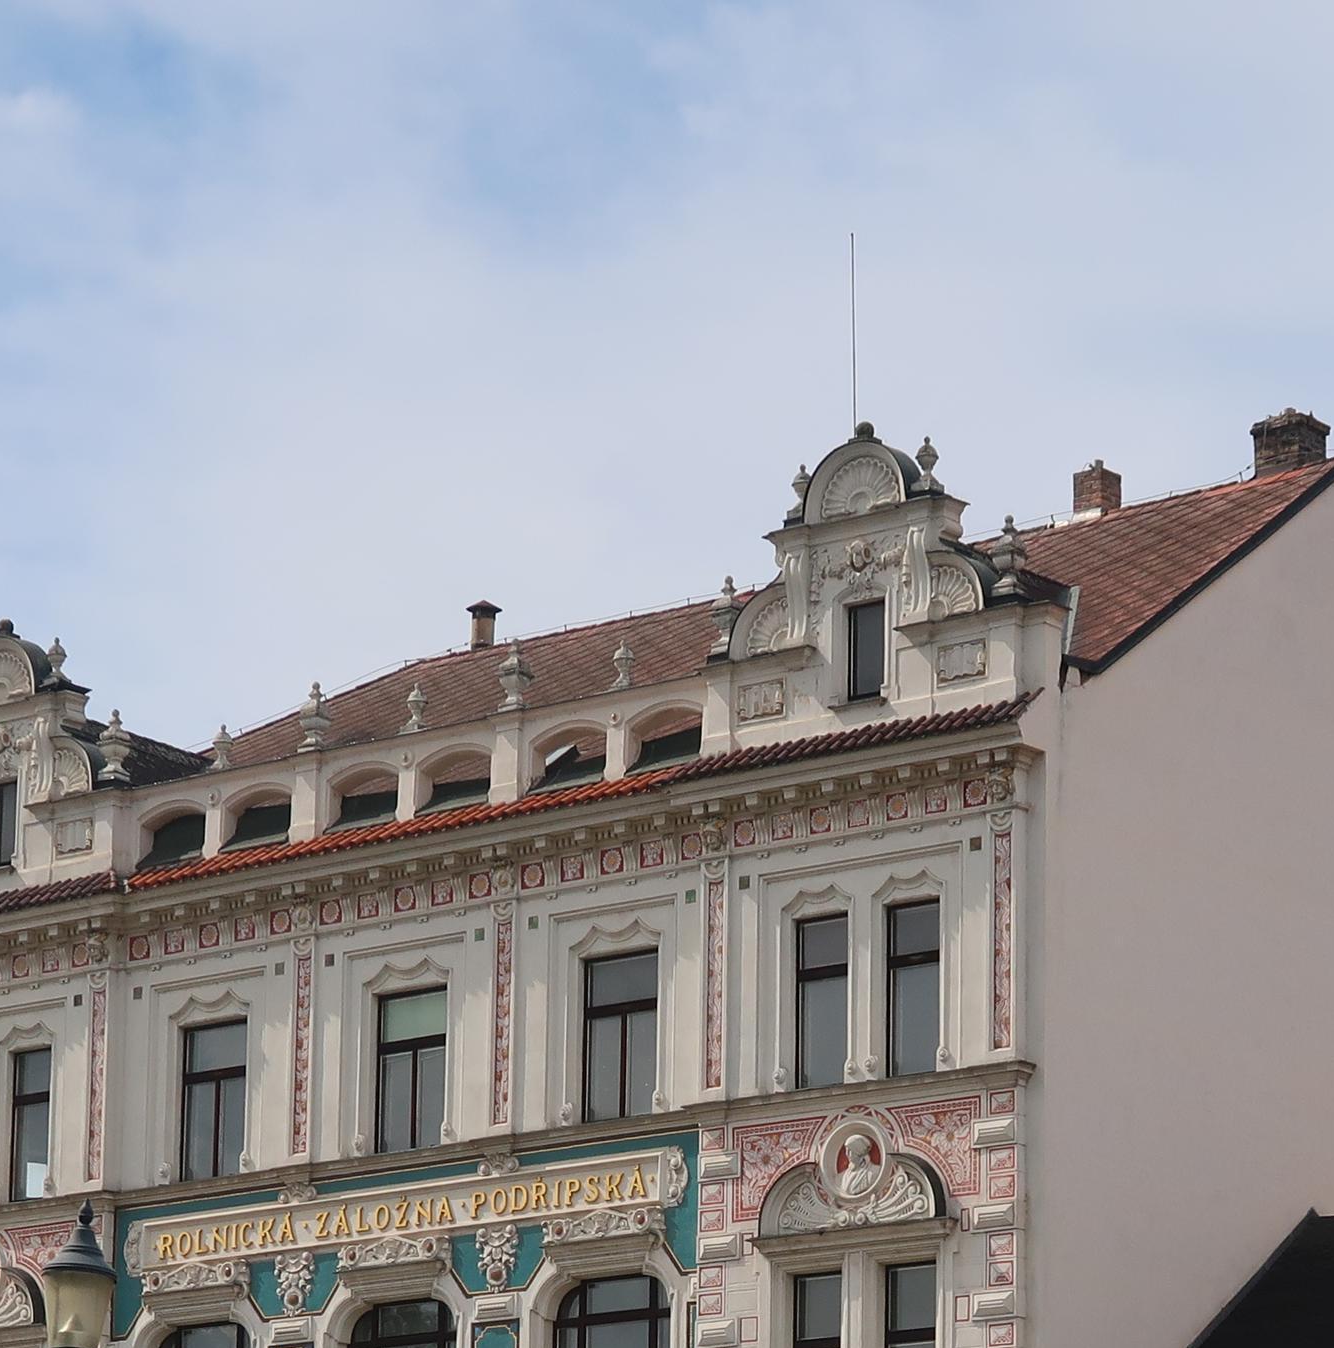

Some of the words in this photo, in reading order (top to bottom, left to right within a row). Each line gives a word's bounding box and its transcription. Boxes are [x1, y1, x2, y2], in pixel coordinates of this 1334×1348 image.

[157, 1211, 297, 1260] ROLNICKÁ
[315, 1195, 454, 1240] ZÁLOŽNA
[469, 1163, 649, 1220] PODŘIPSKÁ
